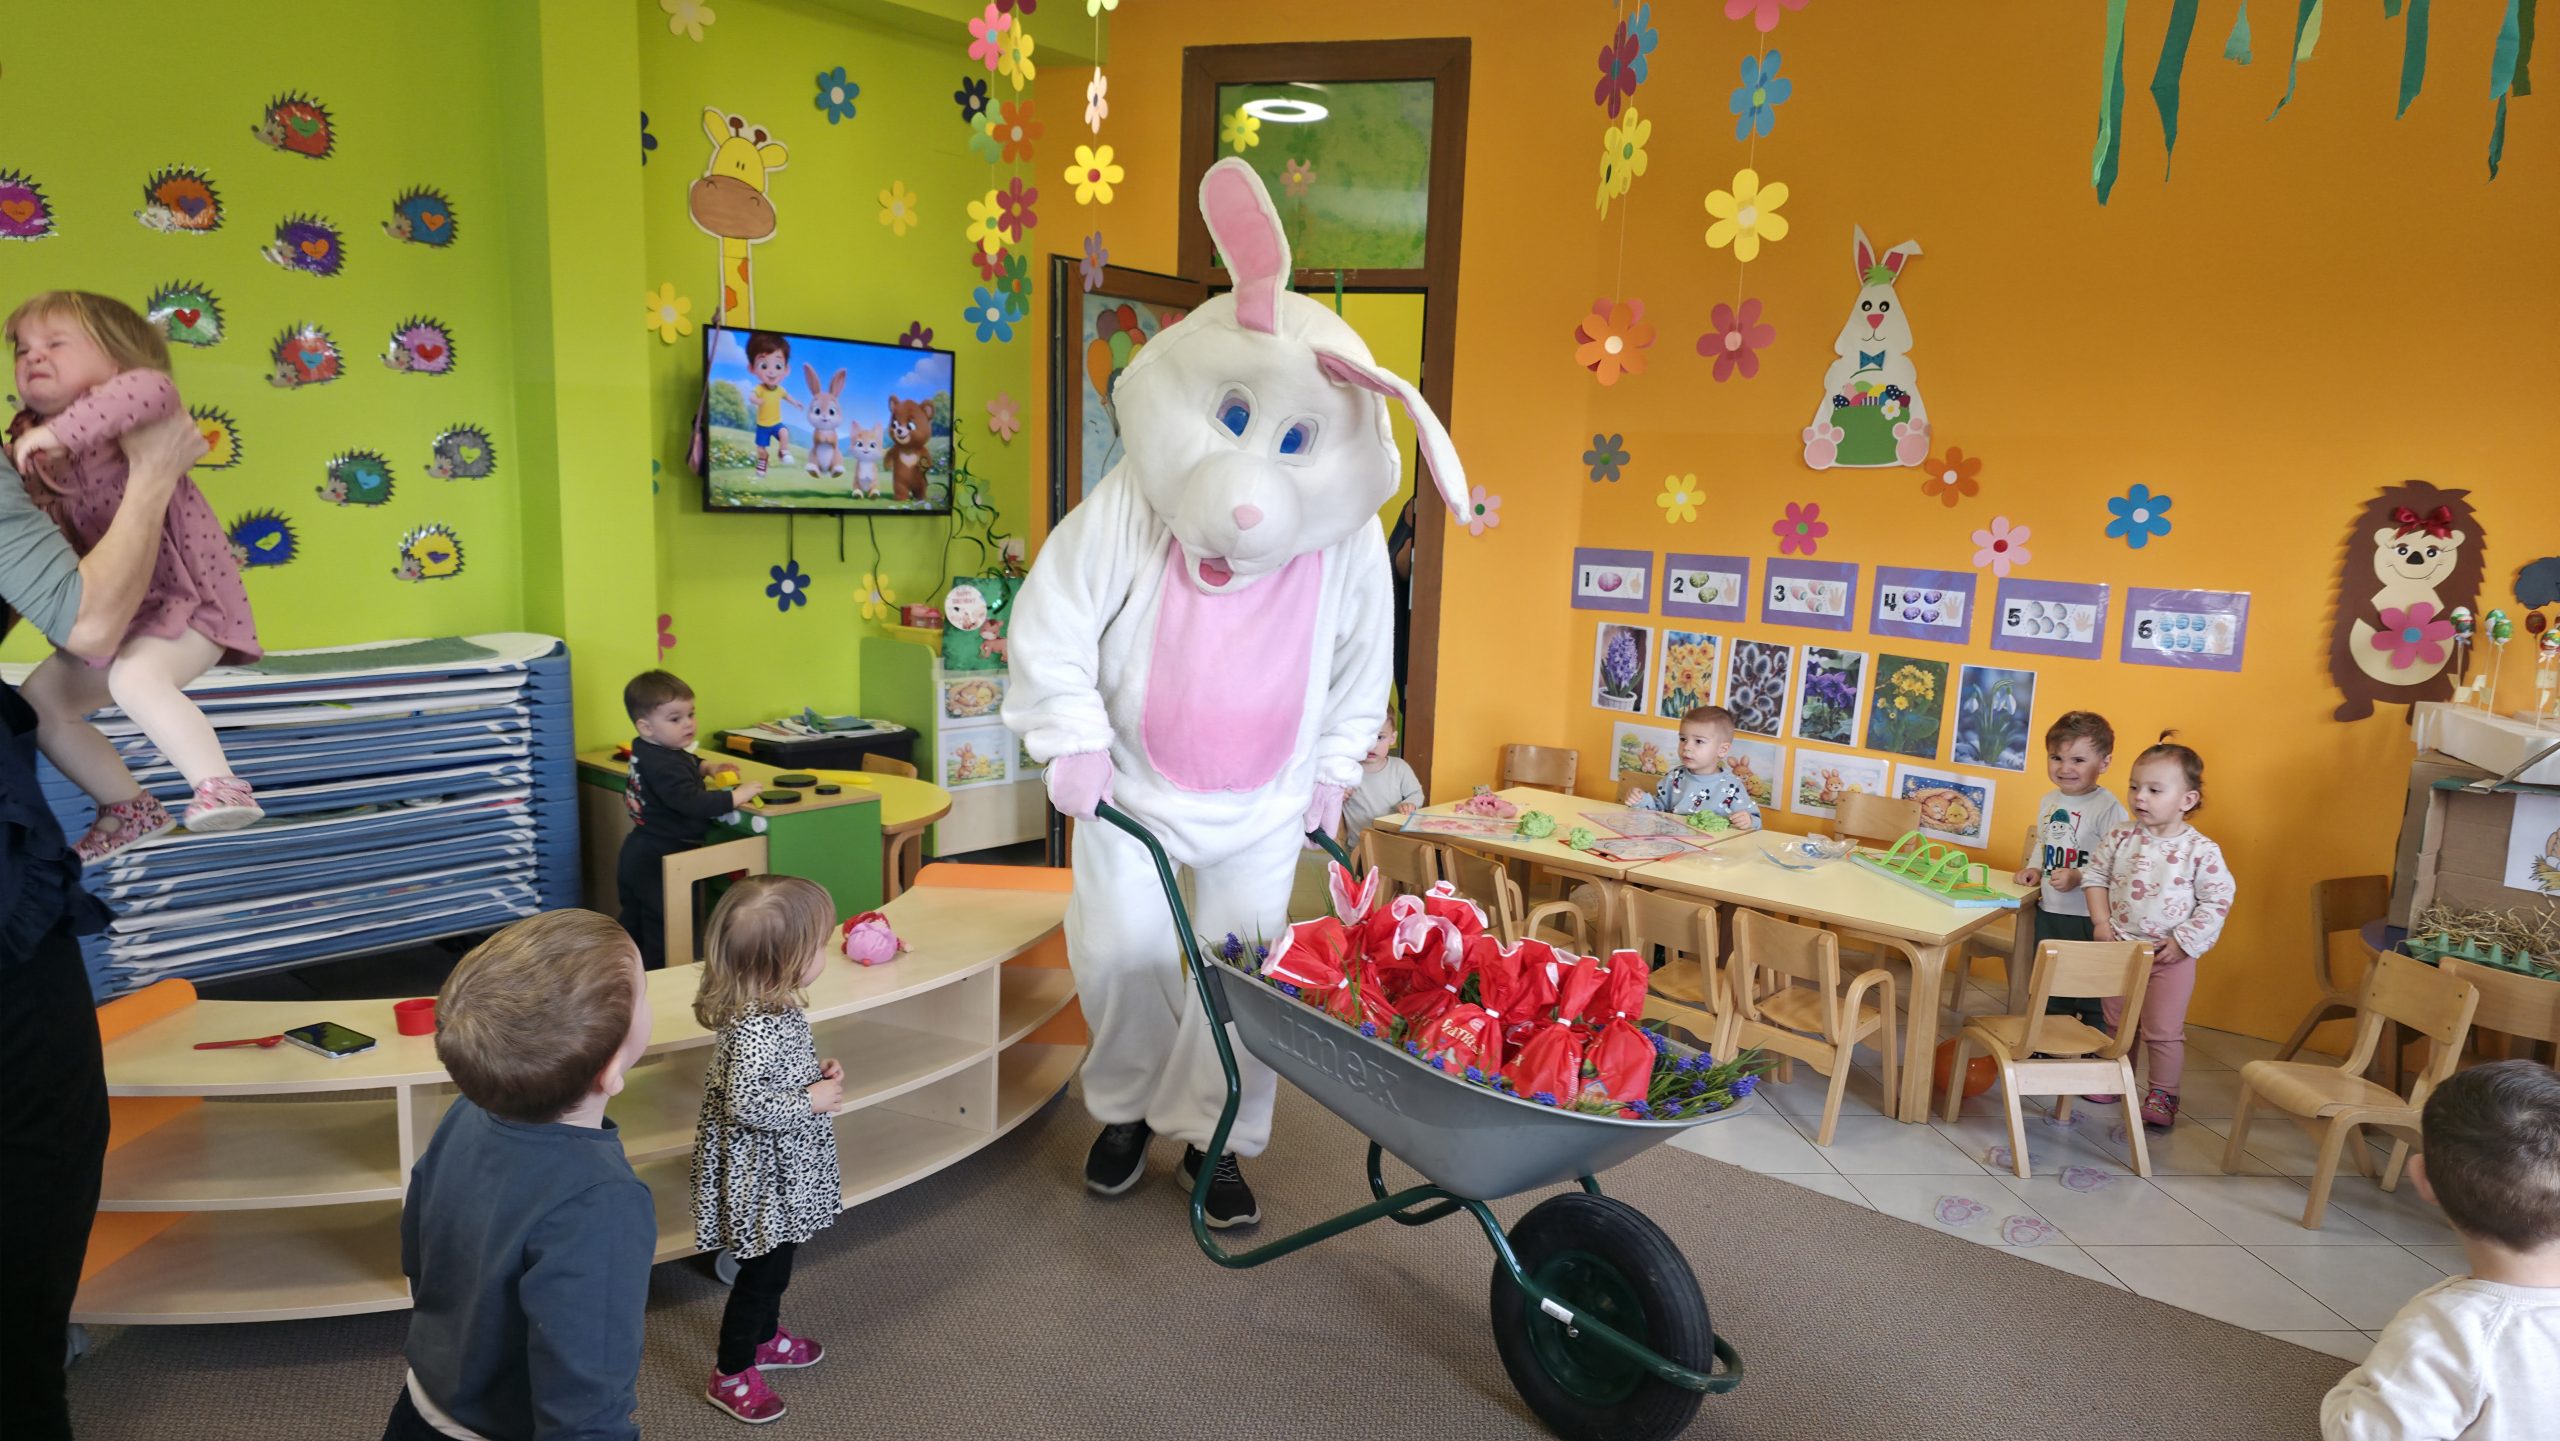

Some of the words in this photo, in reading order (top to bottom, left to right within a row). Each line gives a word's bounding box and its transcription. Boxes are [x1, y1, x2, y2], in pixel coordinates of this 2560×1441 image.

[1585, 571, 1590, 588] 1
[1673, 576, 1684, 593] 2
[1773, 584, 1785, 602] 3
[1884, 592, 1897, 611] 4
[2006, 608, 2021, 627] 5
[2137, 619, 2153, 639] 6
